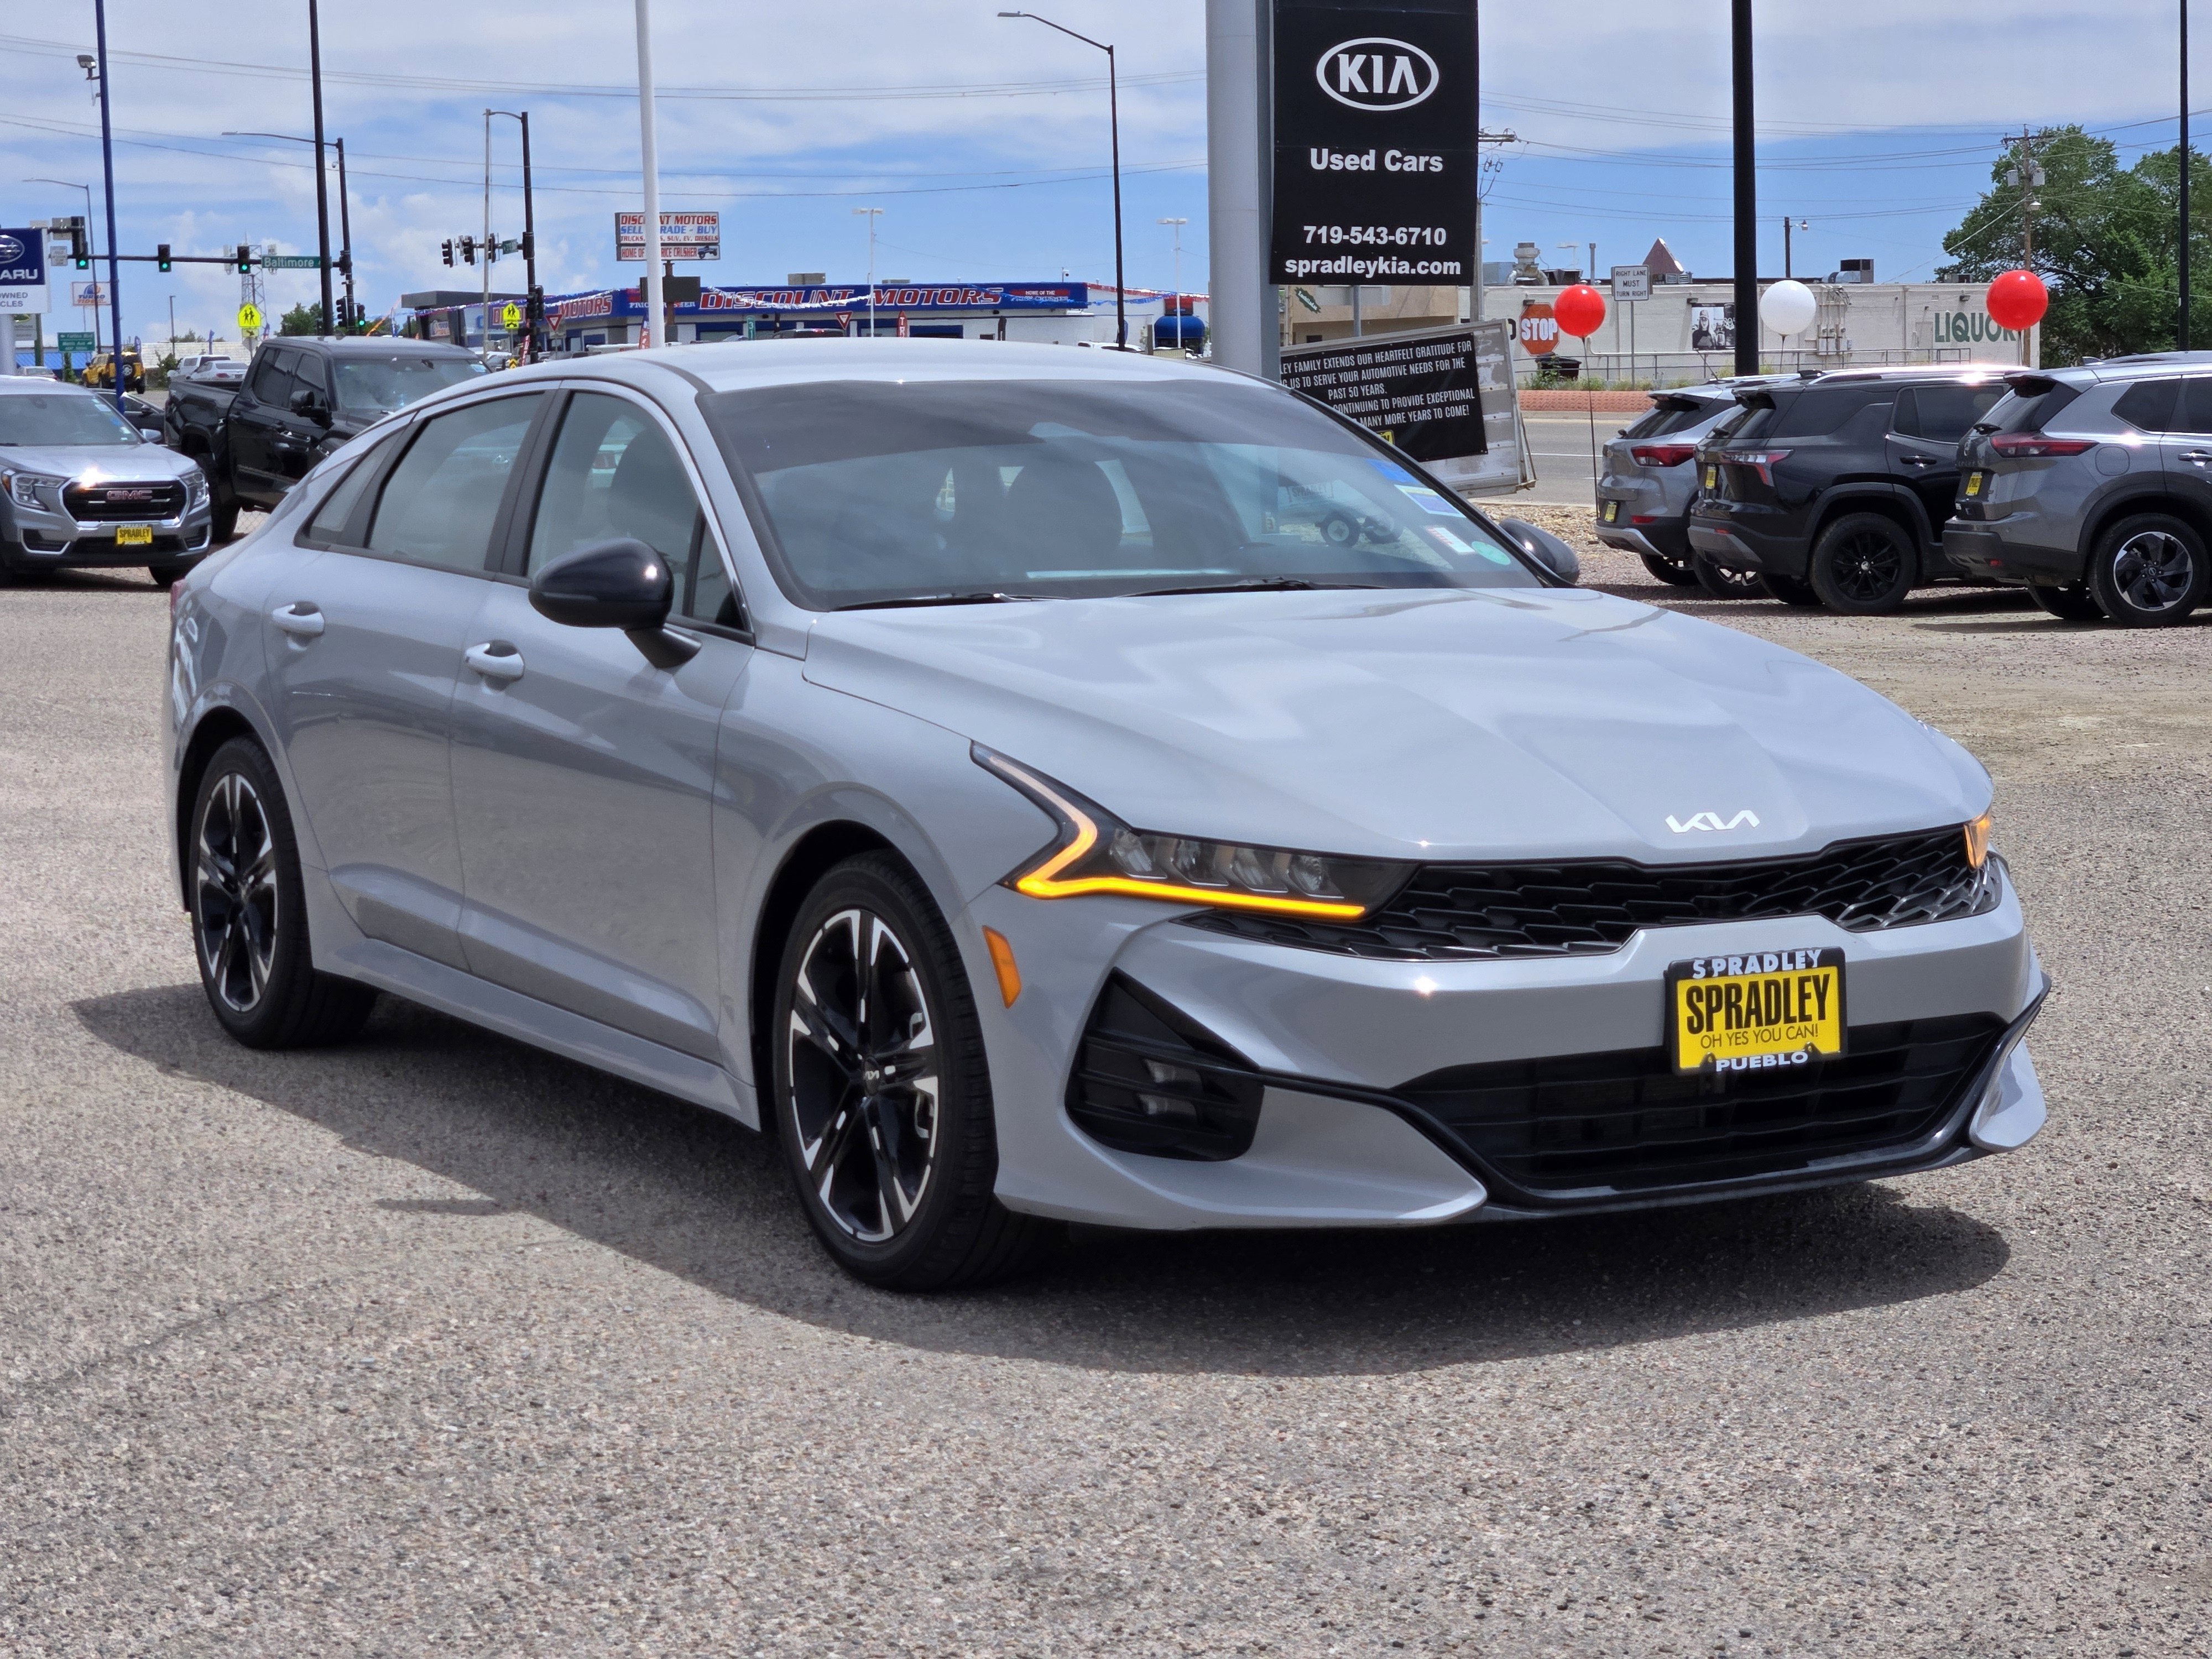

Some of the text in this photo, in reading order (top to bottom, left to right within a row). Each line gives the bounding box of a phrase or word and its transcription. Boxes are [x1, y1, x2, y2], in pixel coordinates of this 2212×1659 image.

[1338, 54, 1418, 95] KIA
[1310, 148, 1443, 172] Used Cars
[621, 215, 717, 225] DISCNT MOTORS
[621, 226, 643, 234] SELL
[660, 226, 687, 234] RADE
[697, 225, 717, 234] BUY
[1303, 226, 1447, 246] 719-543-6710
[264, 257, 314, 267] Baltimore
[622, 247, 697, 258] HOME OF RICE CRUSHER
[0, 269, 38, 280] ARU
[1285, 256, 1461, 278] spradleykia.com
[559, 295, 613, 320] MOTORS
[699, 287, 1004, 310] DISCOUNT MOTORS
[1521, 318, 1558, 341] STOP
[1280, 341, 1472, 375] LEY FAMILY EXTENDS OUR HEARTFELT GRATITUDE FOR
[1290, 377, 1300, 389] US
[1302, 376, 1311, 387] TO
[1313, 373, 1337, 386] SERVE
[1338, 371, 1359, 383] YOUR
[1361, 364, 1407, 380] AUTOMOTIVE
[1410, 362, 1433, 374] NEEDS
[1436, 359, 1451, 371] FOR
[1452, 357, 1465, 369] THE
[1328, 383, 1387, 400] PAST 50 YEARS.
[1380, 399, 1390, 410] TO
[1392, 394, 1425, 409] PROVIDE
[1426, 388, 1475, 404] EXCEPTIONAL
[1360, 405, 1470, 427] MANY MORE YEARS TO COME!
[107, 490, 153, 500] GMC
[119, 529, 150, 538] SPRADLEY
[1665, 810, 1760, 833] KIA
[1693, 949, 1822, 979] SPRADLEY
[1686, 973, 1831, 1035] SPRADLEY
[1700, 1023, 1819, 1049] OH YES YOU CAN!
[1716, 1051, 1809, 1072] PUEBLO
